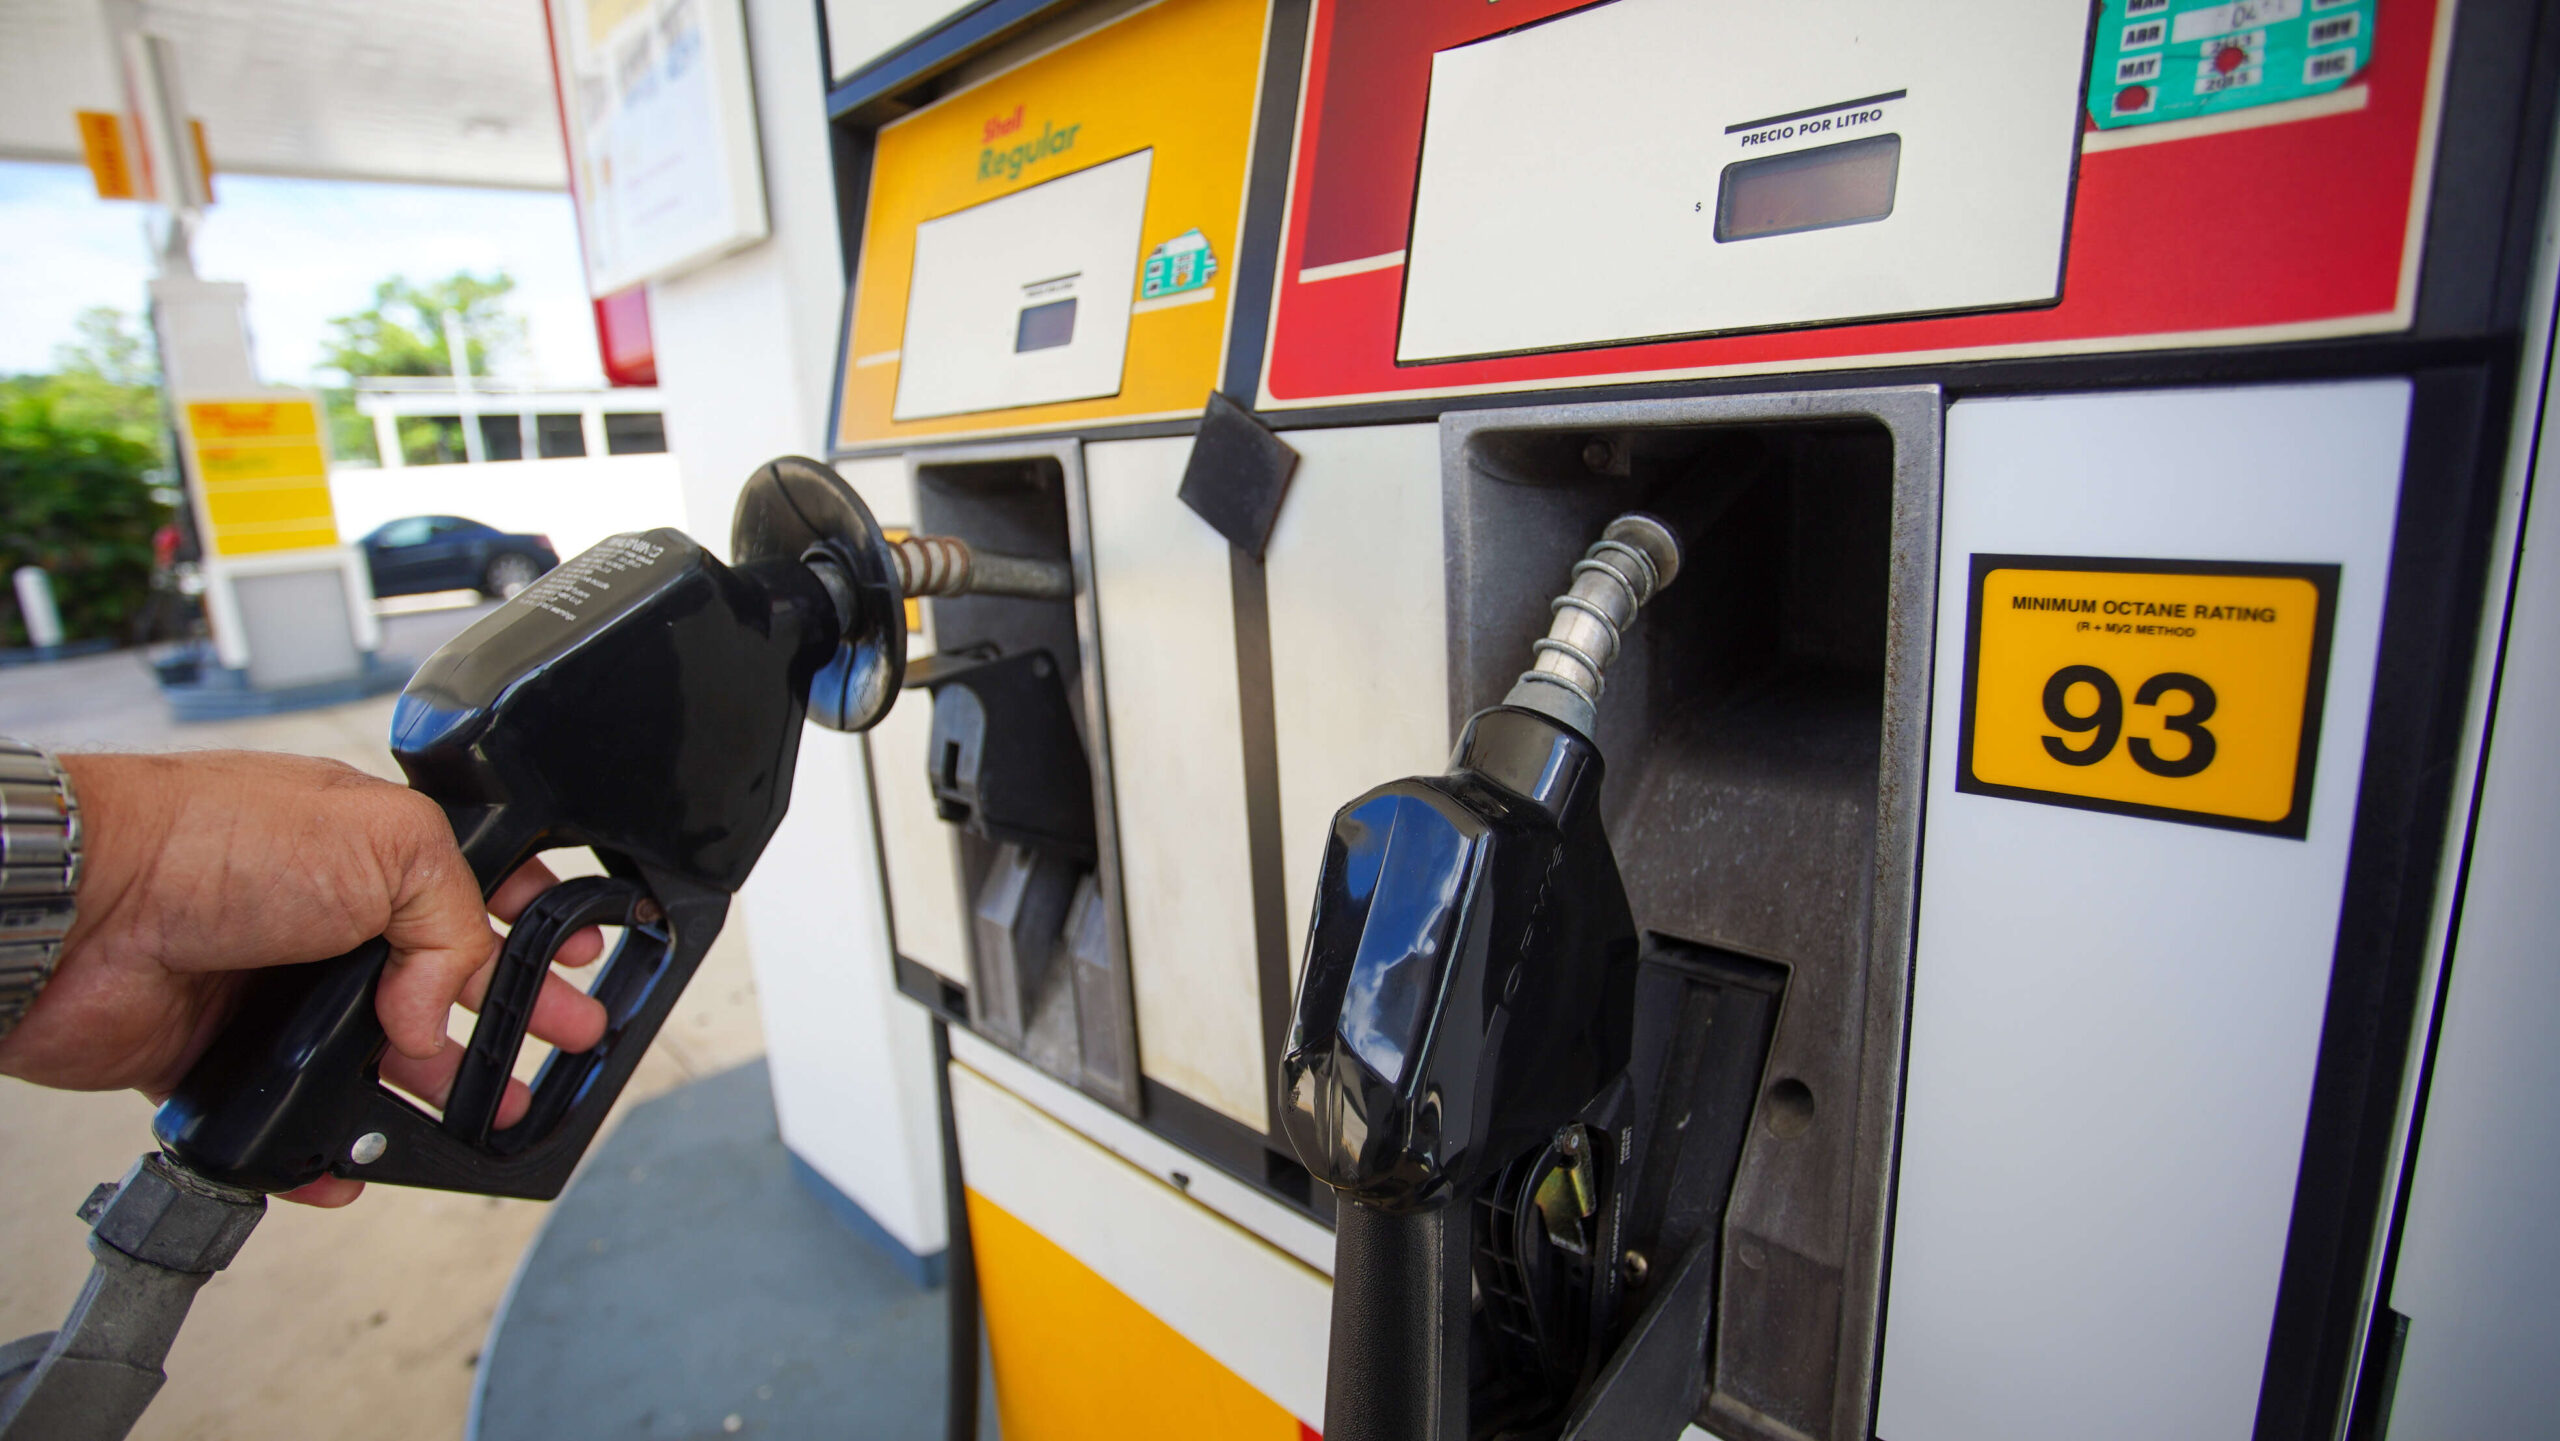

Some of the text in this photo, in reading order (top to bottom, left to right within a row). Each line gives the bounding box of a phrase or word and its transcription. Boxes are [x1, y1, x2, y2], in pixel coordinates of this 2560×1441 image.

[2120, 59, 2156, 78] MAY
[982, 104, 1025, 145] Shell
[1741, 109, 1883, 147] PRECIO POR LITRO
[978, 121, 1081, 180] Regular
[2012, 596, 2277, 623] MINIMUM OCTANE RATING
[2136, 624, 2197, 638] METHOD
[2041, 665, 2217, 778] 93
